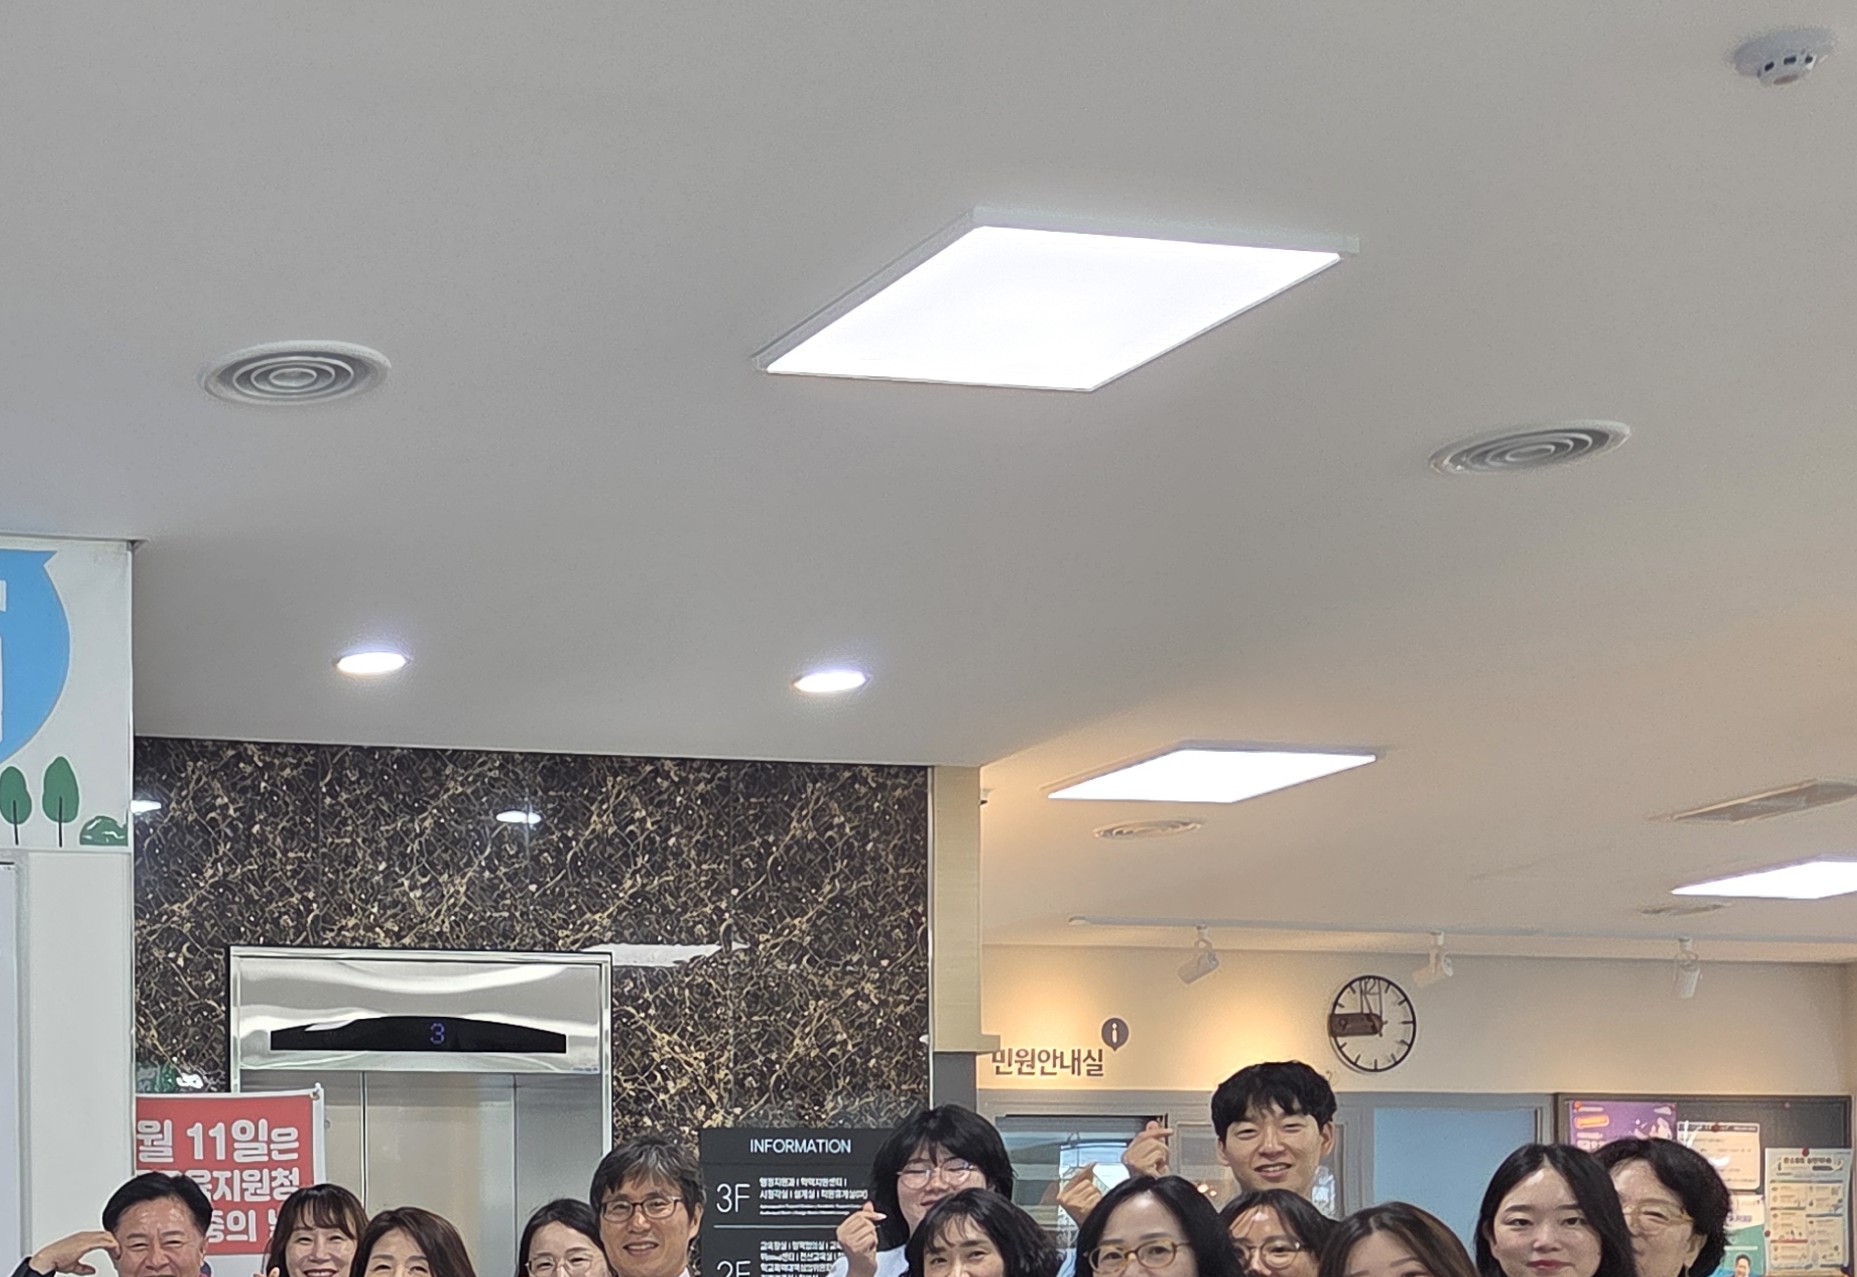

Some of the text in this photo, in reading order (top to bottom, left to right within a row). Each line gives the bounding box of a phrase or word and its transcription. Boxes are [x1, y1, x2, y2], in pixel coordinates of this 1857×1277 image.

[429, 1022, 445, 1045] 3
[991, 1047, 1105, 1077] 민원안내실
[186, 1118, 300, 1162] 11일은
[749, 1138, 852, 1154] INFORMATION
[715, 1183, 751, 1213] 3F
